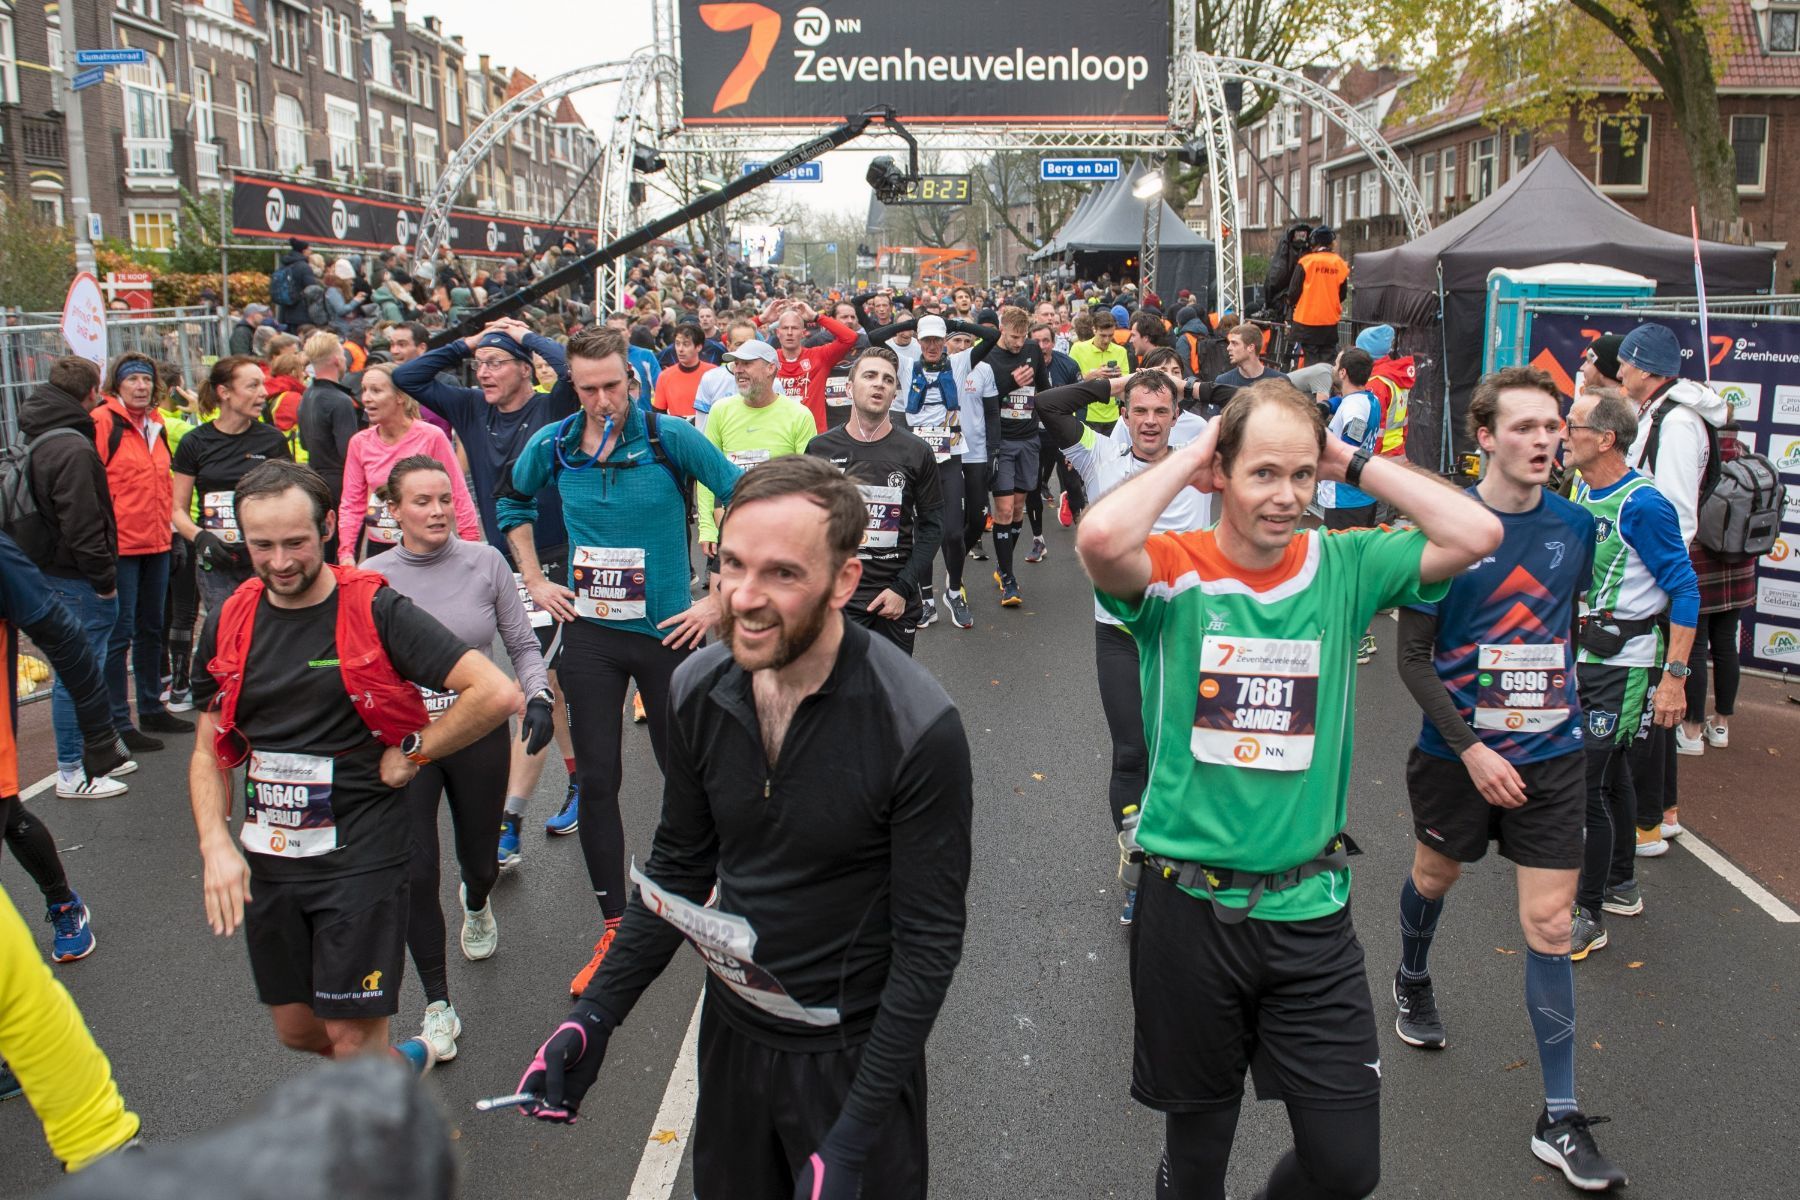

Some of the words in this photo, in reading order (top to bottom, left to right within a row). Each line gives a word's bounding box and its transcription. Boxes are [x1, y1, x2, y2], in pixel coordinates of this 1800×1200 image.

[835, 19, 861, 33] NN
[81, 53, 140, 61] Sumatrastraat
[794, 48, 1148, 90] Zevenheuvelenloop
[773, 161, 789, 175] Jib
[791, 155, 800, 167] in
[801, 140, 832, 162] Motion
[1047, 163, 1074, 176] Berg
[1077, 165, 1091, 173] en
[1094, 163, 1114, 173] Dal
[286, 203, 300, 219] NN
[348, 214, 360, 228] NN
[1733, 350, 1800, 363] Zevenheuve
[592, 569, 622, 586] 2177
[590, 586, 627, 599] LENNARD
[1769, 589, 1798, 599] provincie
[1206, 621, 1230, 631] FBT
[1778, 636, 1792, 647] AA
[1501, 671, 1549, 691] 6996
[1236, 677, 1295, 708] 7681
[1233, 708, 1292, 731] SANDER
[1265, 746, 1285, 758] NN
[255, 782, 309, 809] 16649
[288, 839, 301, 847] NN
[683, 908, 735, 942] 2022
[362, 990, 383, 998] BEVER
